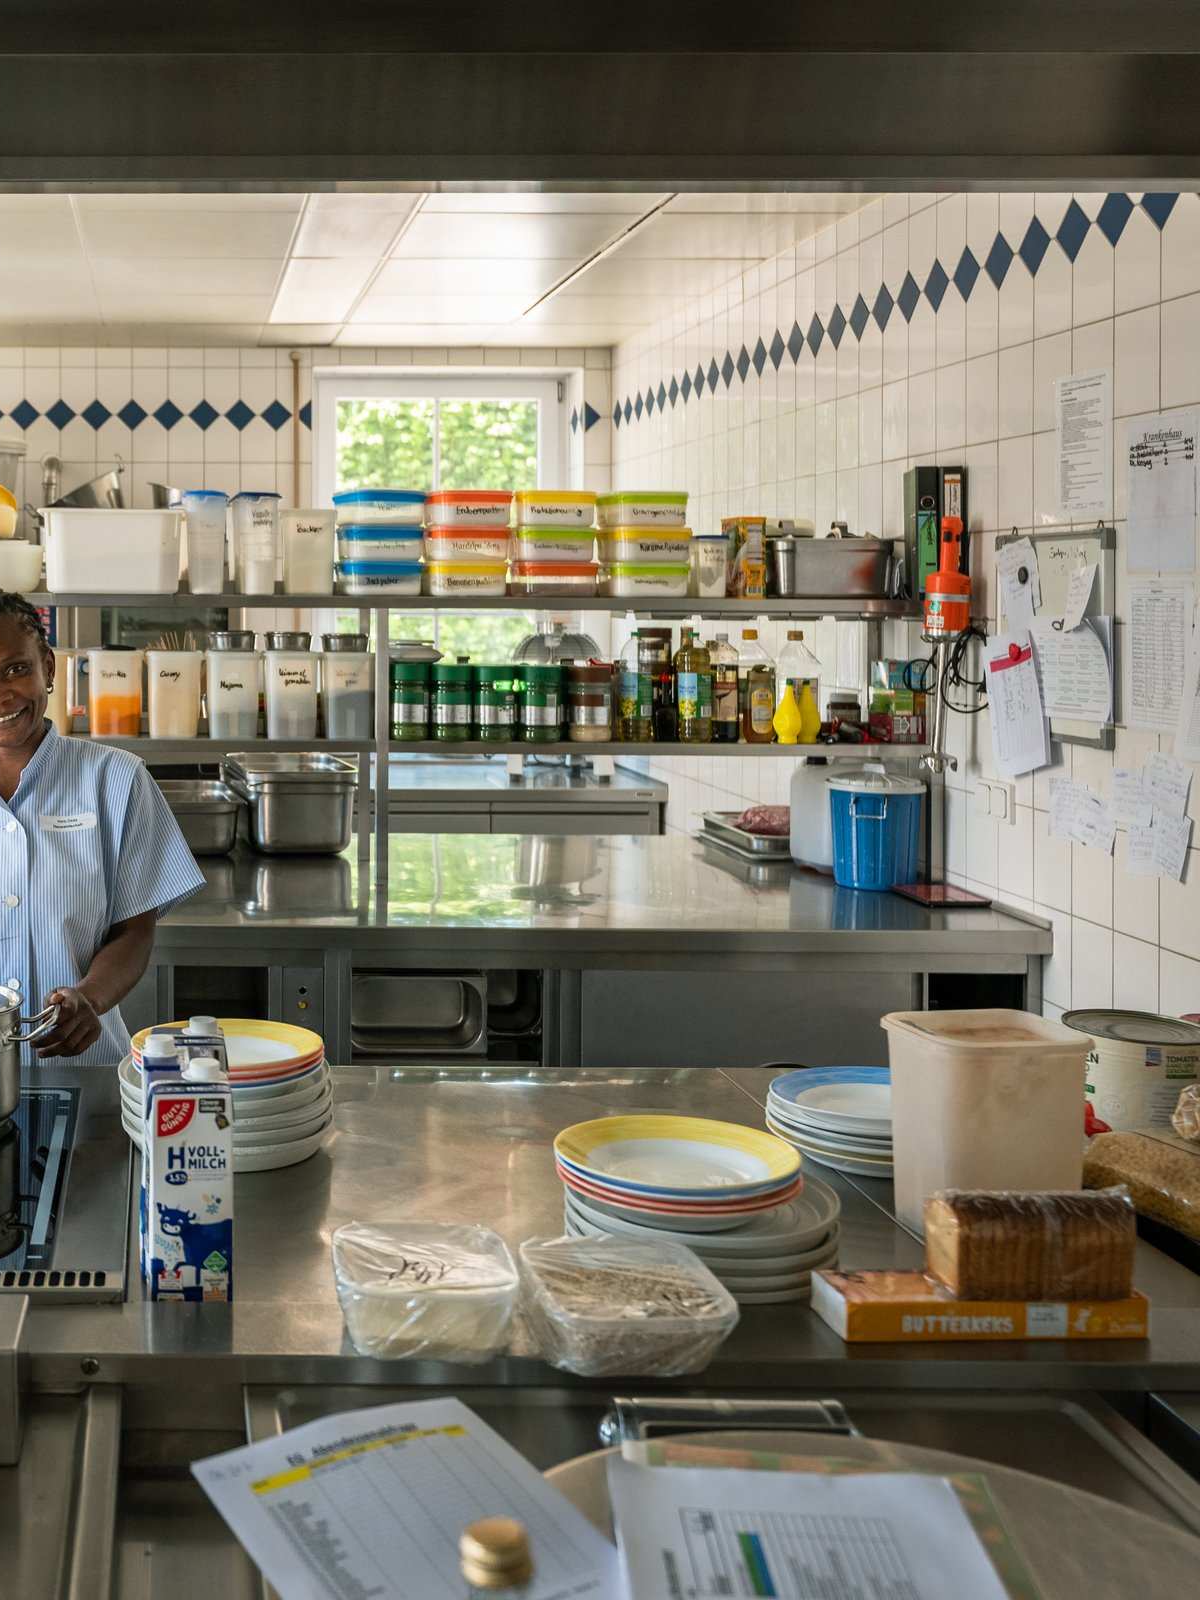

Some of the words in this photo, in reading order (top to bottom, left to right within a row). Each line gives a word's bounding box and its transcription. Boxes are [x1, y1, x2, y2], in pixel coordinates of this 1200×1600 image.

[160, 1102, 191, 1132] GÜNSTIG
[168, 1146, 186, 1169] H
[188, 1146, 225, 1158] VOLL-
[188, 1158, 227, 1169] MILCH
[901, 1314, 1014, 1335] BUTTERKEKS
